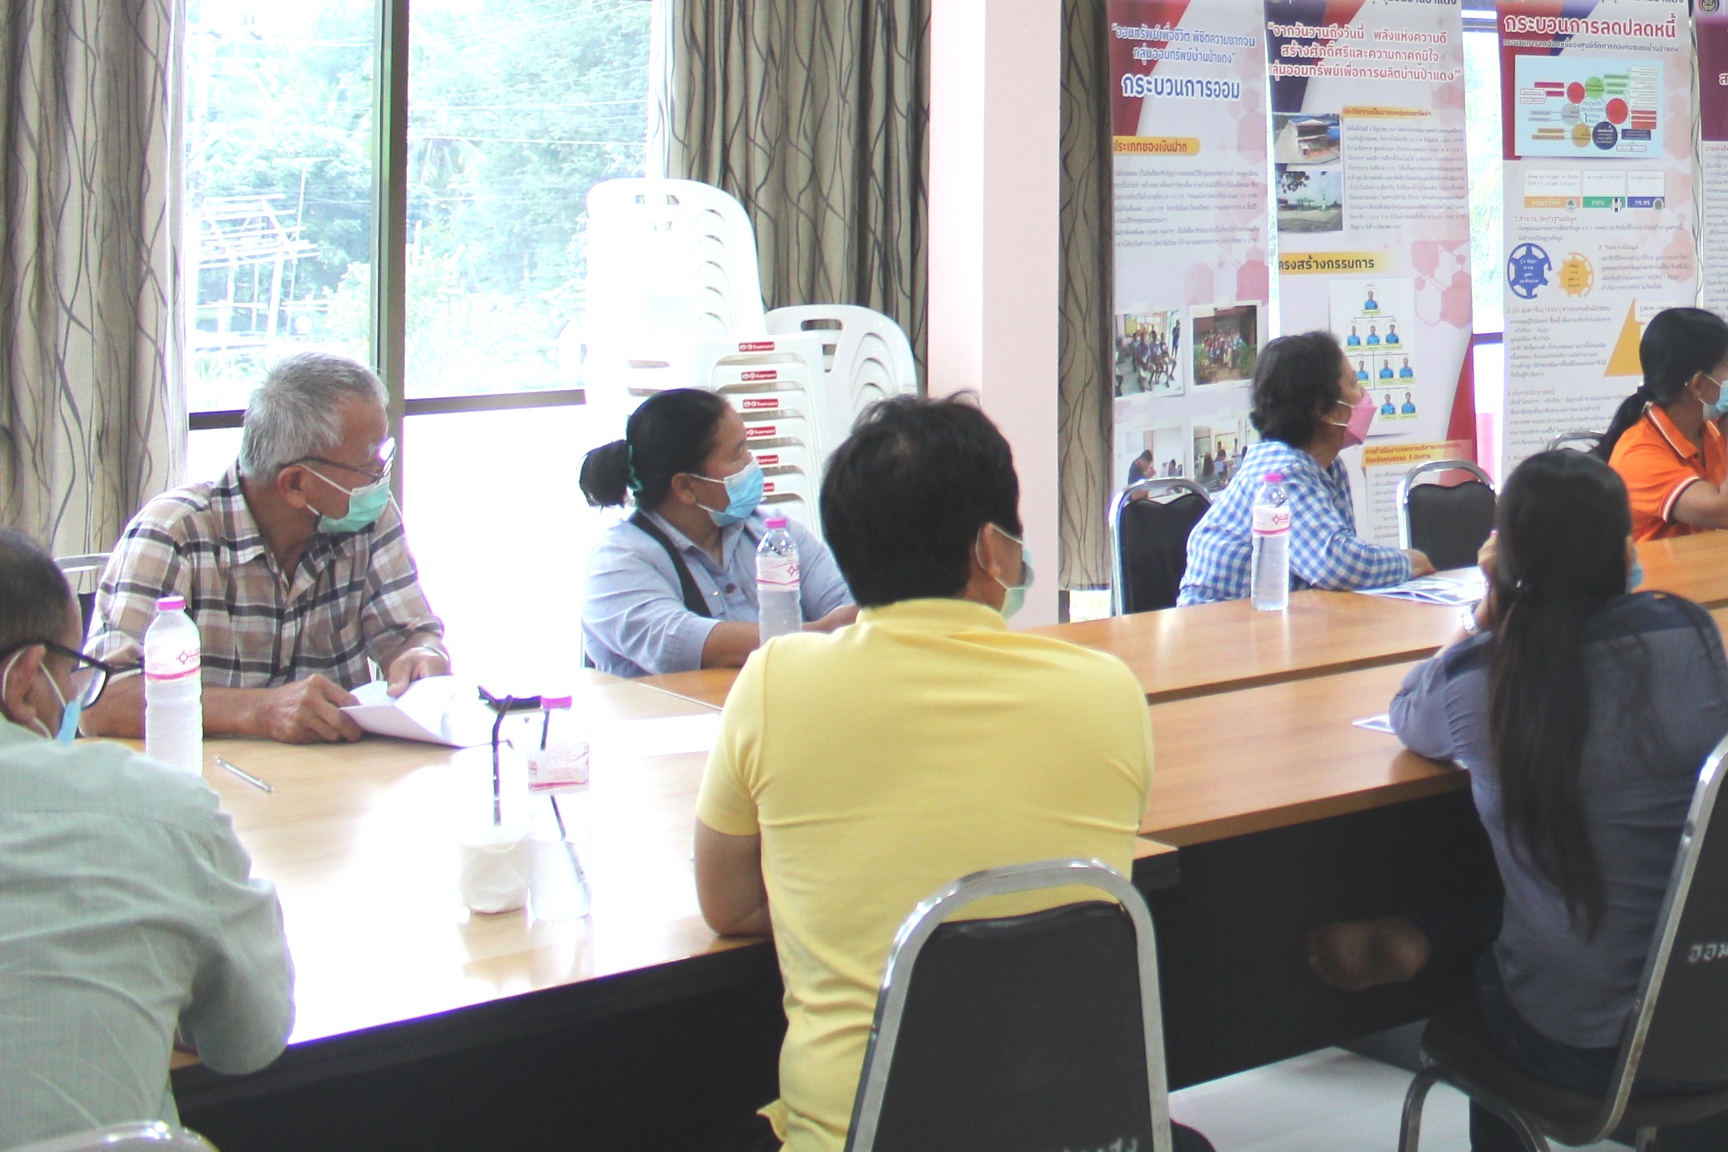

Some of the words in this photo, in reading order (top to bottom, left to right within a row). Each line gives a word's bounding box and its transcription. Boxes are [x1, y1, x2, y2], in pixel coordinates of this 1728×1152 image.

[1504, 13, 1677, 39] กระบวนการลดปลดหนี้
[1122, 74, 1240, 99] กระบวนการออม
